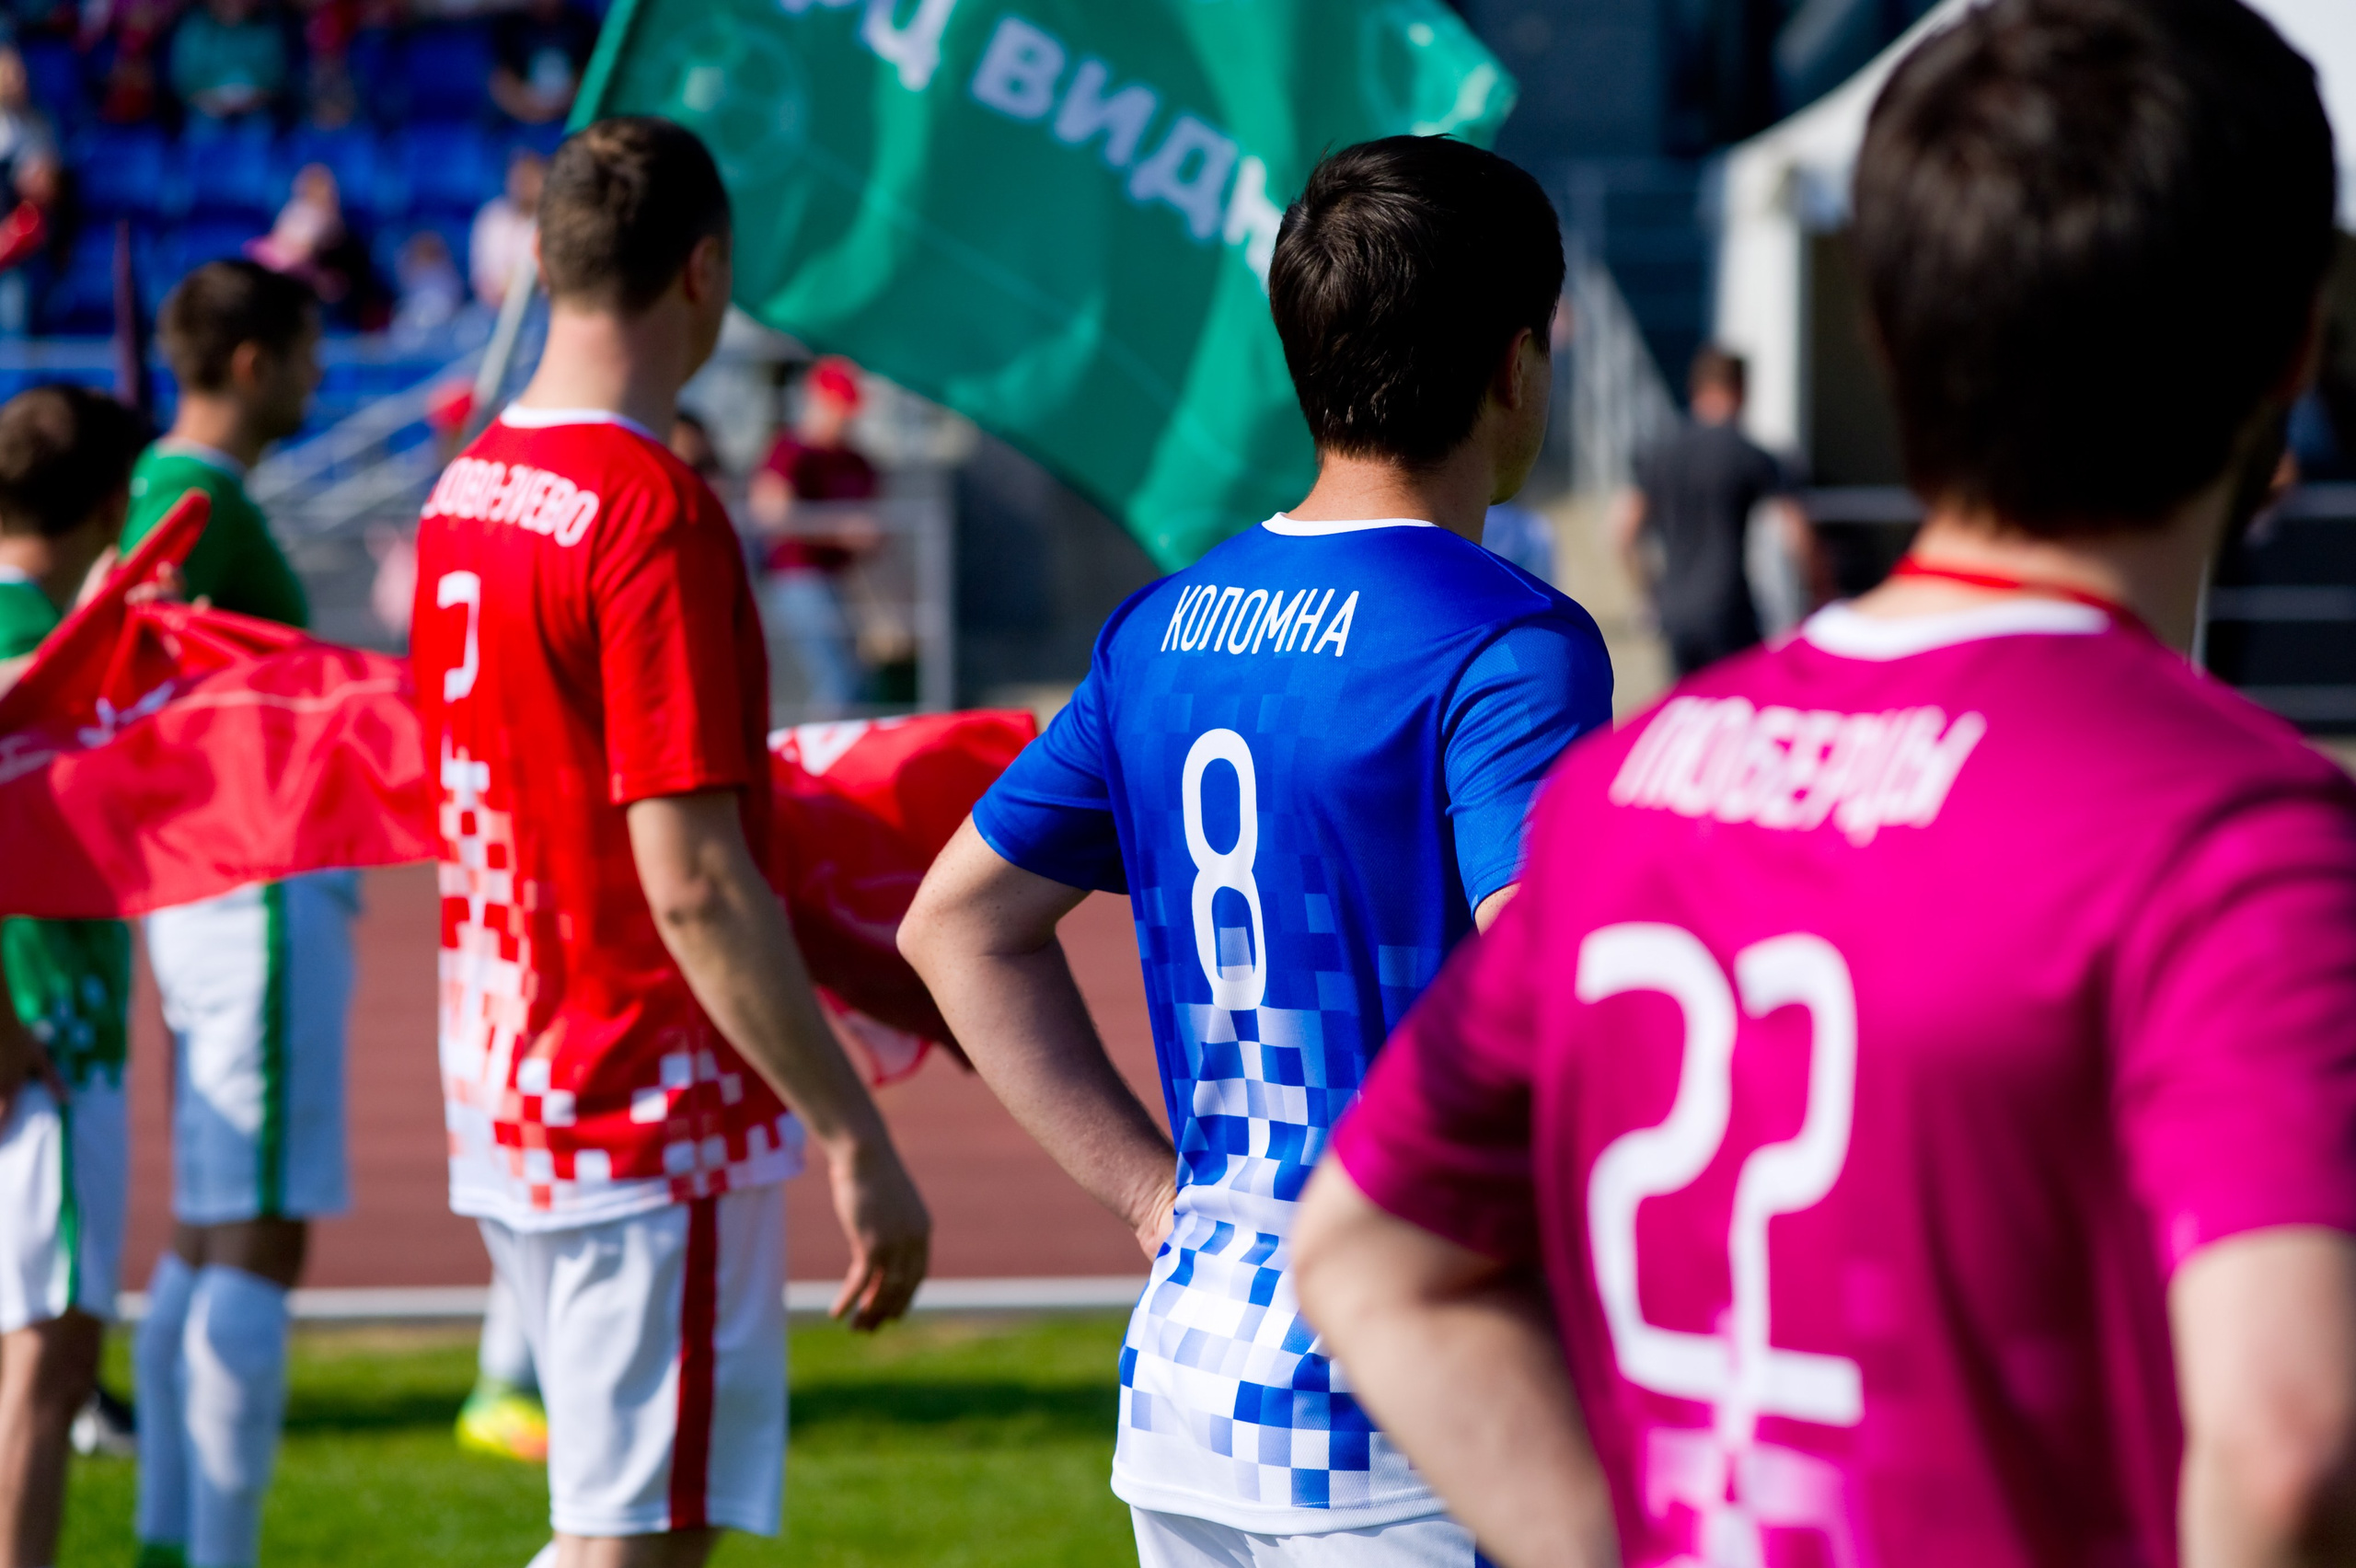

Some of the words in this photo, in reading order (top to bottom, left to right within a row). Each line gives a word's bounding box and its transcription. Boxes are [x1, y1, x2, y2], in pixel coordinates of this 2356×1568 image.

[1160, 584, 1359, 657] КОЛОМНА
[1182, 728, 1266, 1010] 8
[1575, 921, 1865, 1427] 22
